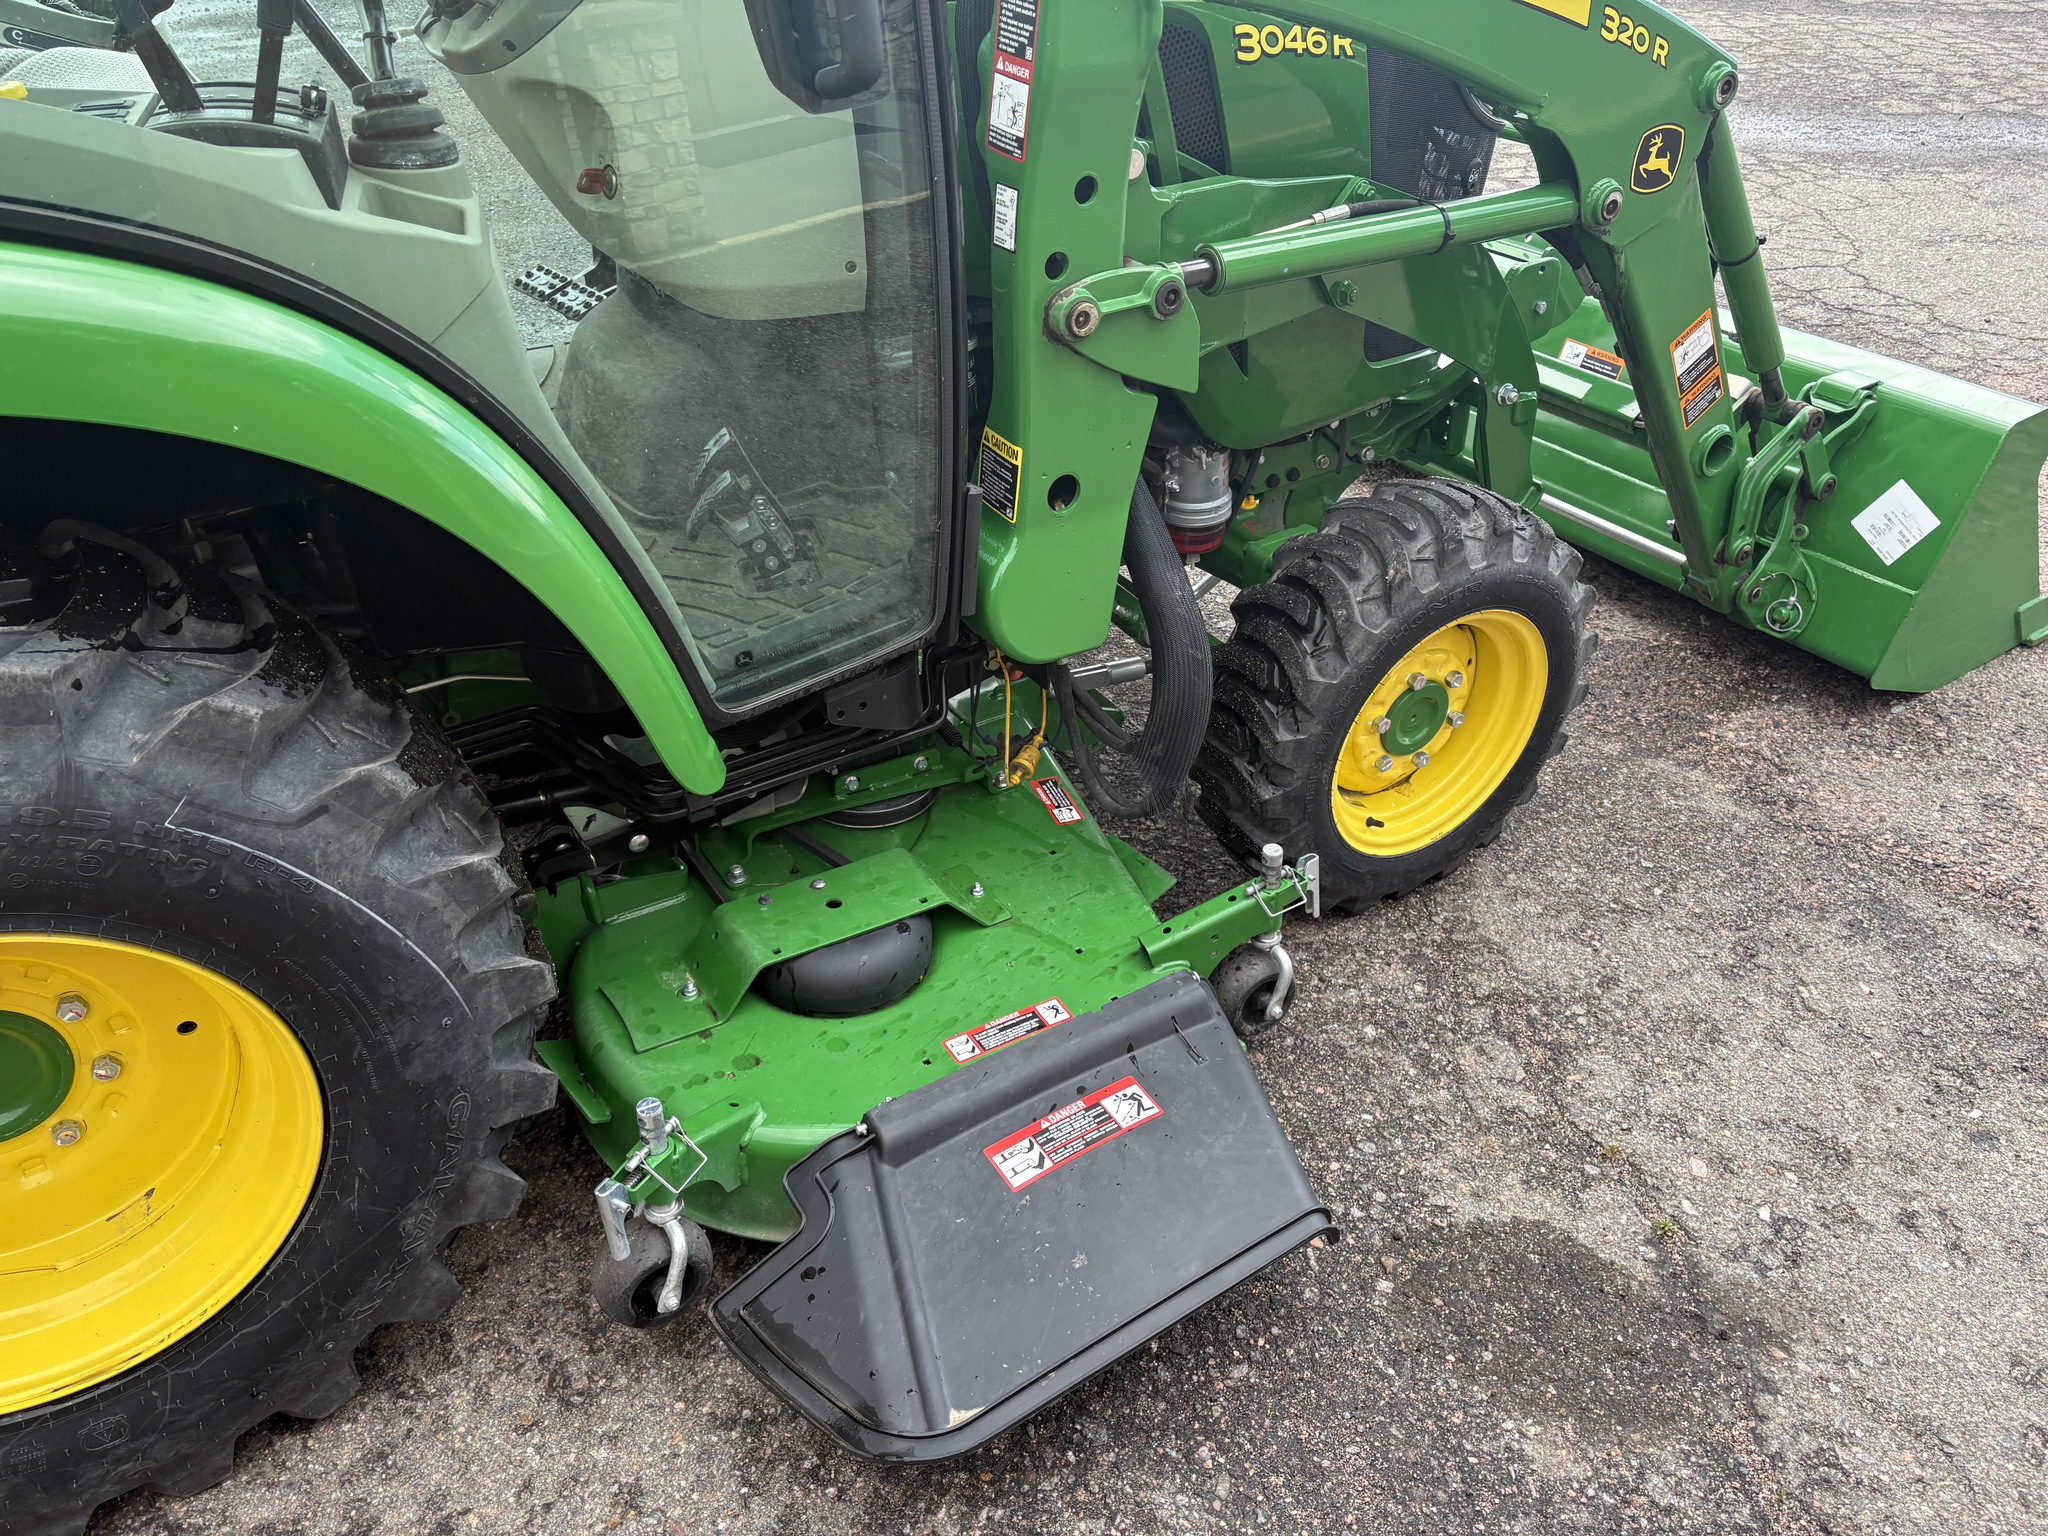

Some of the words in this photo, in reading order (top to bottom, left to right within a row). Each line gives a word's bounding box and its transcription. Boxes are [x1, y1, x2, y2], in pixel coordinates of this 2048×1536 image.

[1005, 61, 1030, 79] DANGER
[1681, 315, 1707, 340] WARNING
[1597, 350, 1619, 363] WARNING
[1691, 372, 1716, 397] WARNING
[991, 434, 1018, 462] CAUTION
[57, 833, 209, 871] RATING
[244, 851, 317, 895] R-4
[990, 1012, 1020, 1027] DANGER
[1048, 1100, 1086, 1124] DANGER
